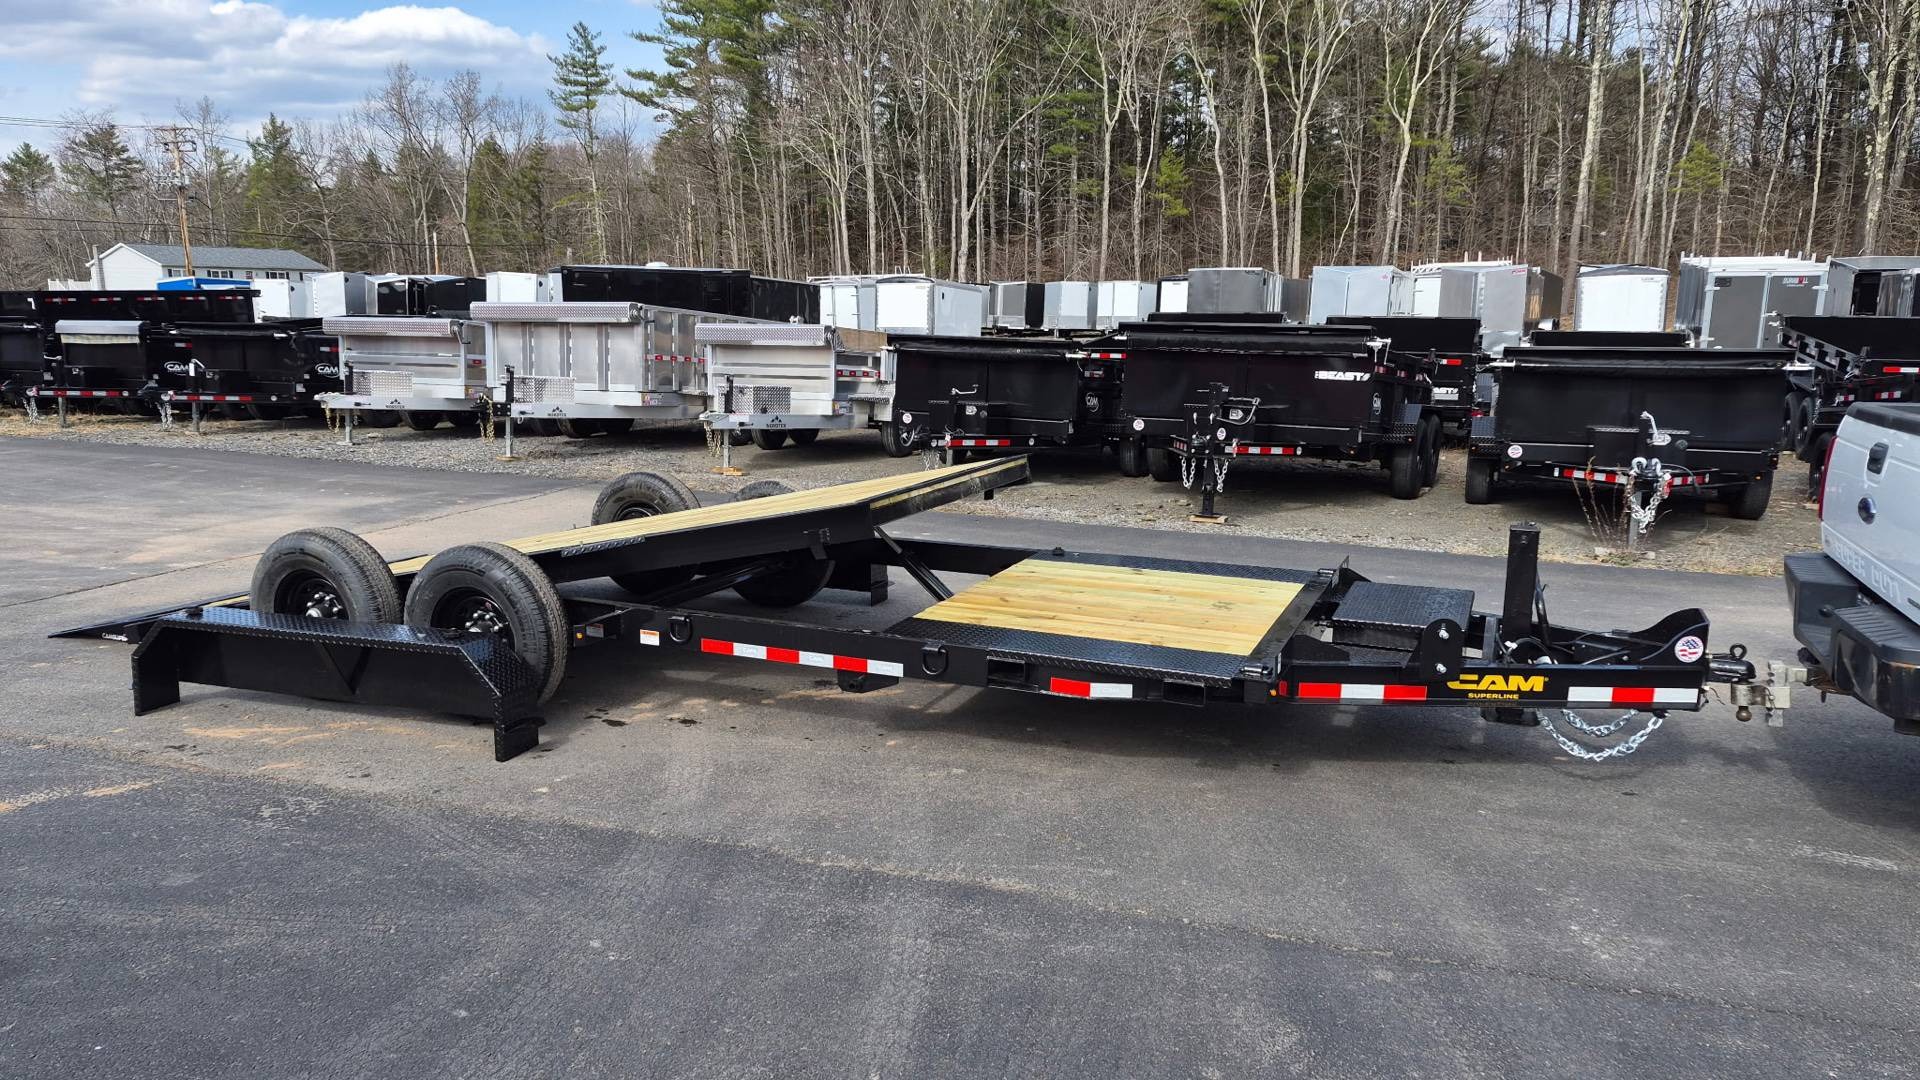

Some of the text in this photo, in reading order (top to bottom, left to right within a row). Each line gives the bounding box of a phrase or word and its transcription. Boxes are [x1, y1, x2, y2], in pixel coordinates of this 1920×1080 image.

[1319, 370, 1371, 382] BEAST
[1433, 386, 1459, 395] AST
[1447, 674, 1545, 692] CAM
[1467, 692, 1519, 700] SUPERLINE
